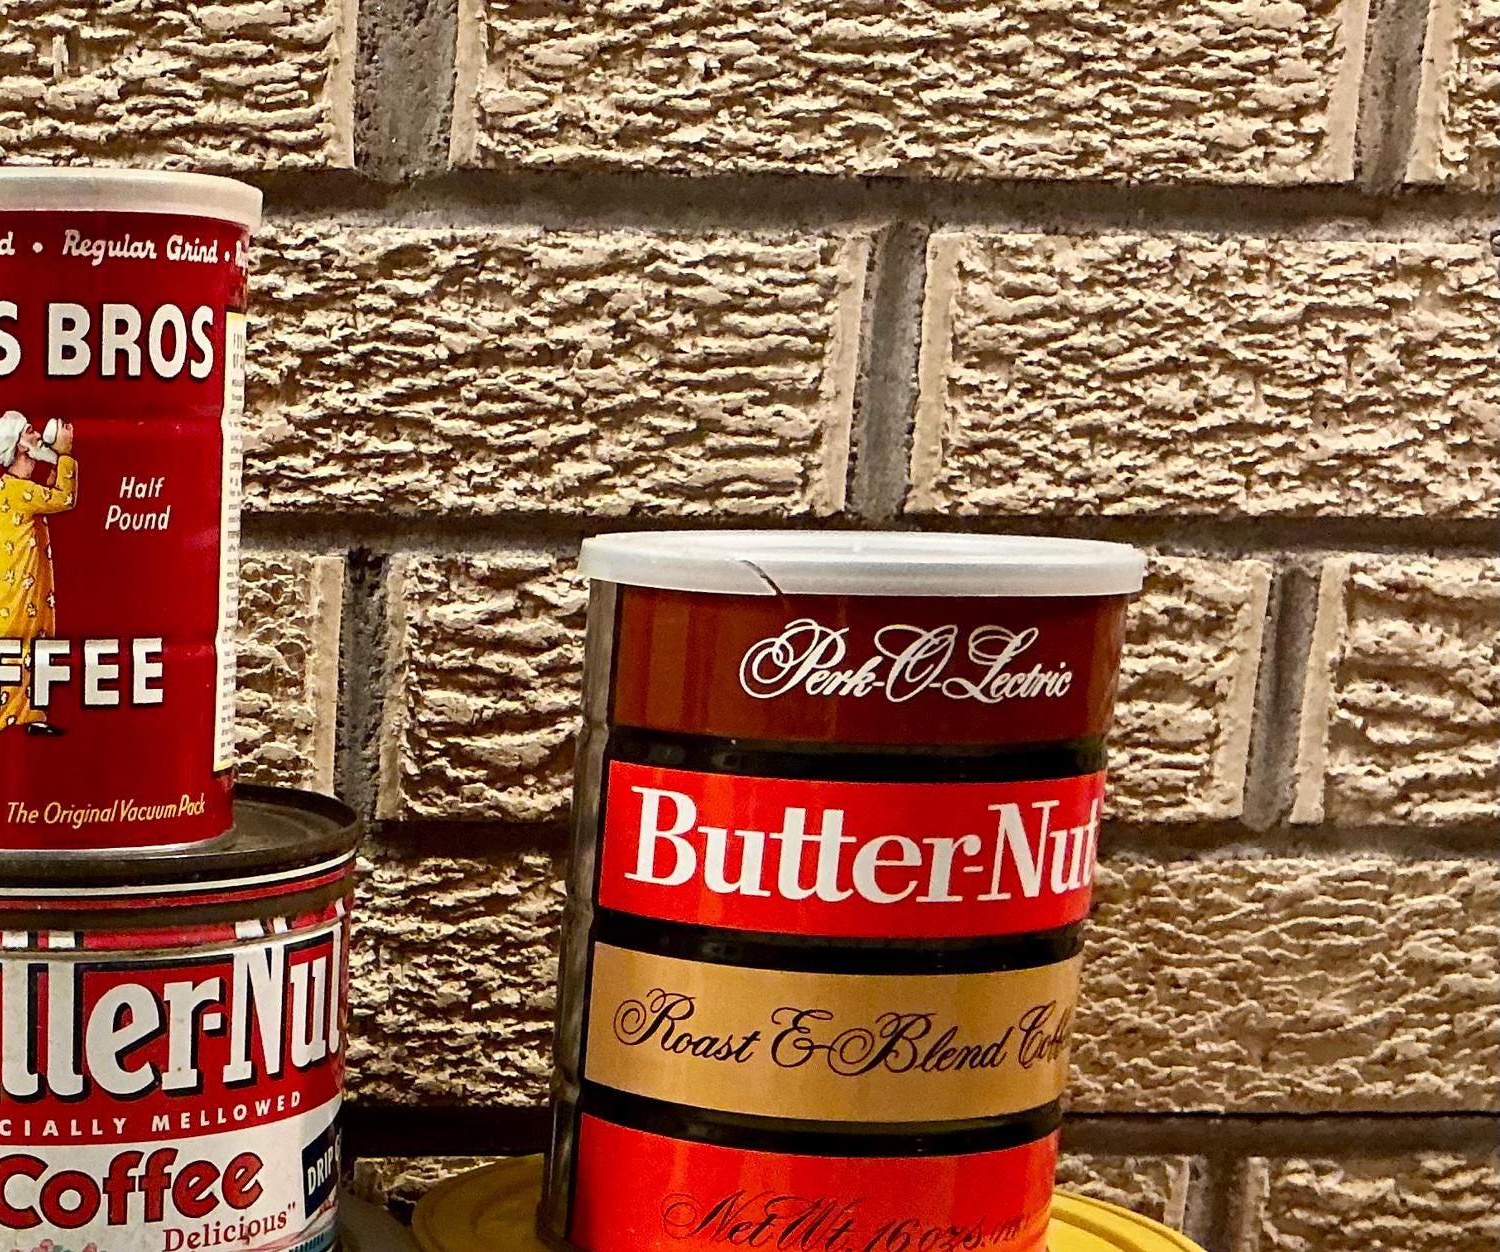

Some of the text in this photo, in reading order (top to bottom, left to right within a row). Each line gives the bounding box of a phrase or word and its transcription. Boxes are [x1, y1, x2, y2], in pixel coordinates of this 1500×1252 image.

[62, 229, 157, 266] Regular
[166, 235, 218, 263] Grind
[48, 304, 215, 379] BROS
[119, 477, 165, 499] Half
[105, 505, 171, 531] Pound
[7, 793, 206, 830] The Original Vacuum Pack
[625, 785, 1100, 904] Butter-Nut
[613, 988, 761, 1065] Roast
[827, 1008, 1015, 1078] Blend
[151, 1091, 302, 1132] MELLOWED
[307, 1145, 334, 1195] DRIP
[662, 1189, 774, 1245] Net
